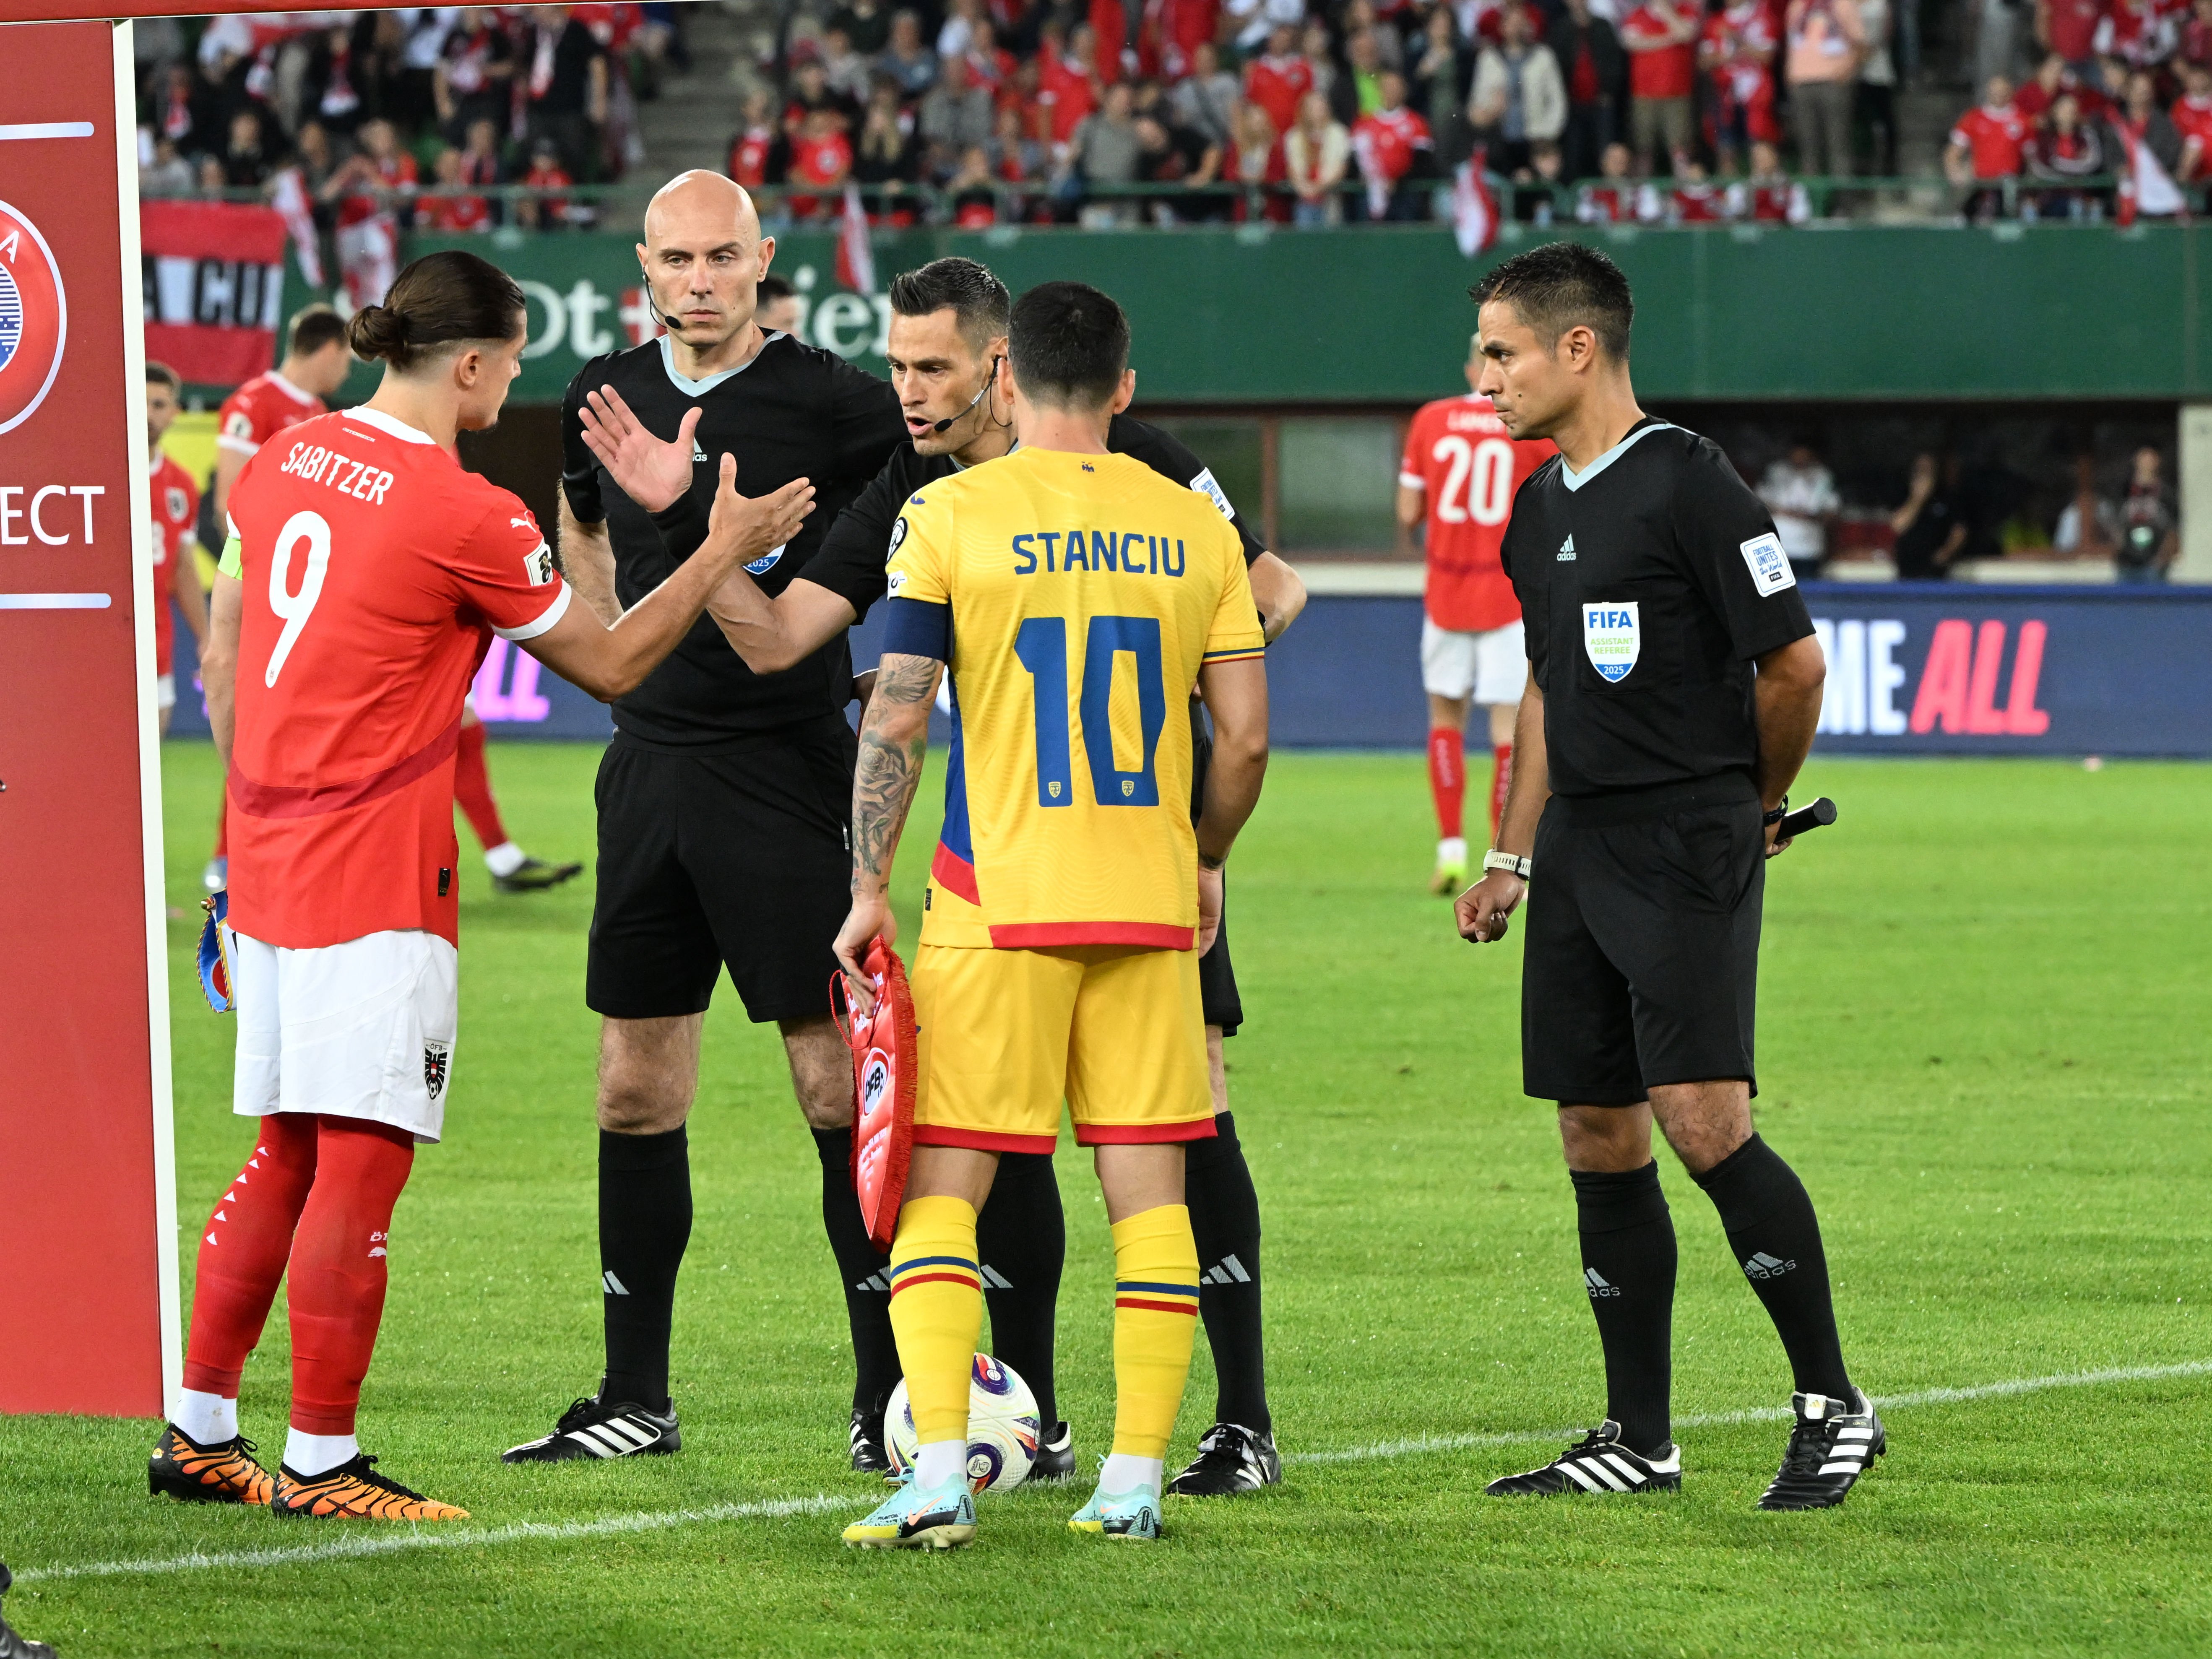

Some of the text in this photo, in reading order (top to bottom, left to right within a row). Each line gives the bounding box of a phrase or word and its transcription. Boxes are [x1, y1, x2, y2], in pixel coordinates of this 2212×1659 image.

[281, 442, 394, 505] SABITZER
[1433, 435, 1515, 526] 20
[1012, 530, 1185, 577] STANCIU
[1557, 551, 1577, 561] adidas
[1753, 544, 1774, 556] FOOTBALL
[1756, 551, 1778, 566] UNITES
[1768, 560, 1783, 572] World
[265, 510, 331, 688] 9
[1589, 611, 1633, 628] FIFA
[1604, 666, 1624, 674] 2025
[1908, 618, 2050, 735] ALL
[1014, 616, 1166, 807] 10
[1744, 1259, 1796, 1279] adidas
